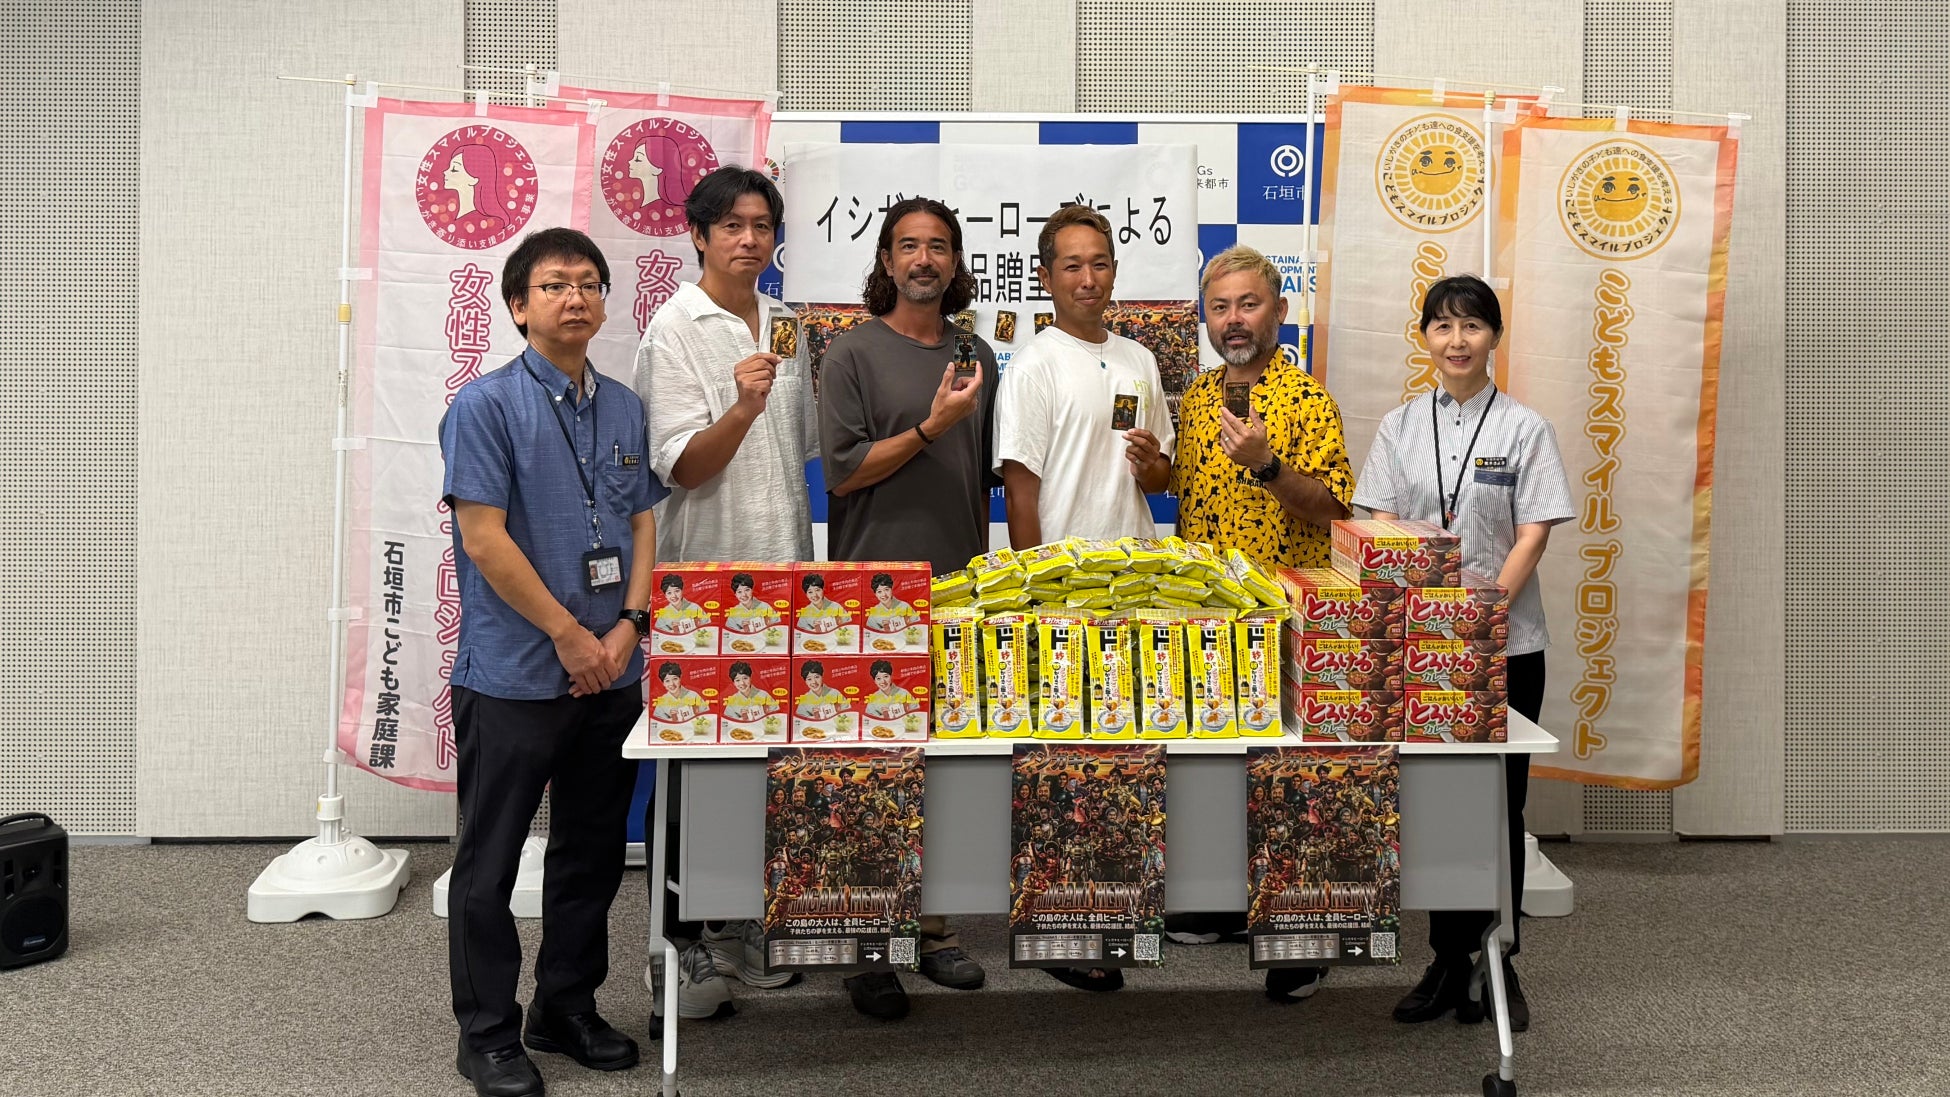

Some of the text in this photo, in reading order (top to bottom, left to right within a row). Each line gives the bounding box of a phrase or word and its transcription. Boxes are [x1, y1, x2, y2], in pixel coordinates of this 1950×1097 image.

[417, 126, 538, 187] 女性スマイルプロジェクト
[1363, 544, 1431, 570] とろける
[1376, 569, 1404, 580] カレー
[1306, 594, 1374, 622] とろける
[1410, 595, 1479, 622] とろける
[1319, 620, 1348, 630] カレー
[1424, 620, 1451, 631] カレー
[368, 541, 405, 769] 石垣市こども家庭課
[1304, 646, 1374, 673] とろける
[1407, 646, 1477, 673] とろける
[1318, 673, 1347, 682] カレー
[1422, 672, 1449, 682] カレー
[1305, 697, 1374, 725] とろける
[1408, 698, 1479, 725] とろける
[1319, 724, 1348, 734] カレー
[1423, 724, 1450, 735] カレー
